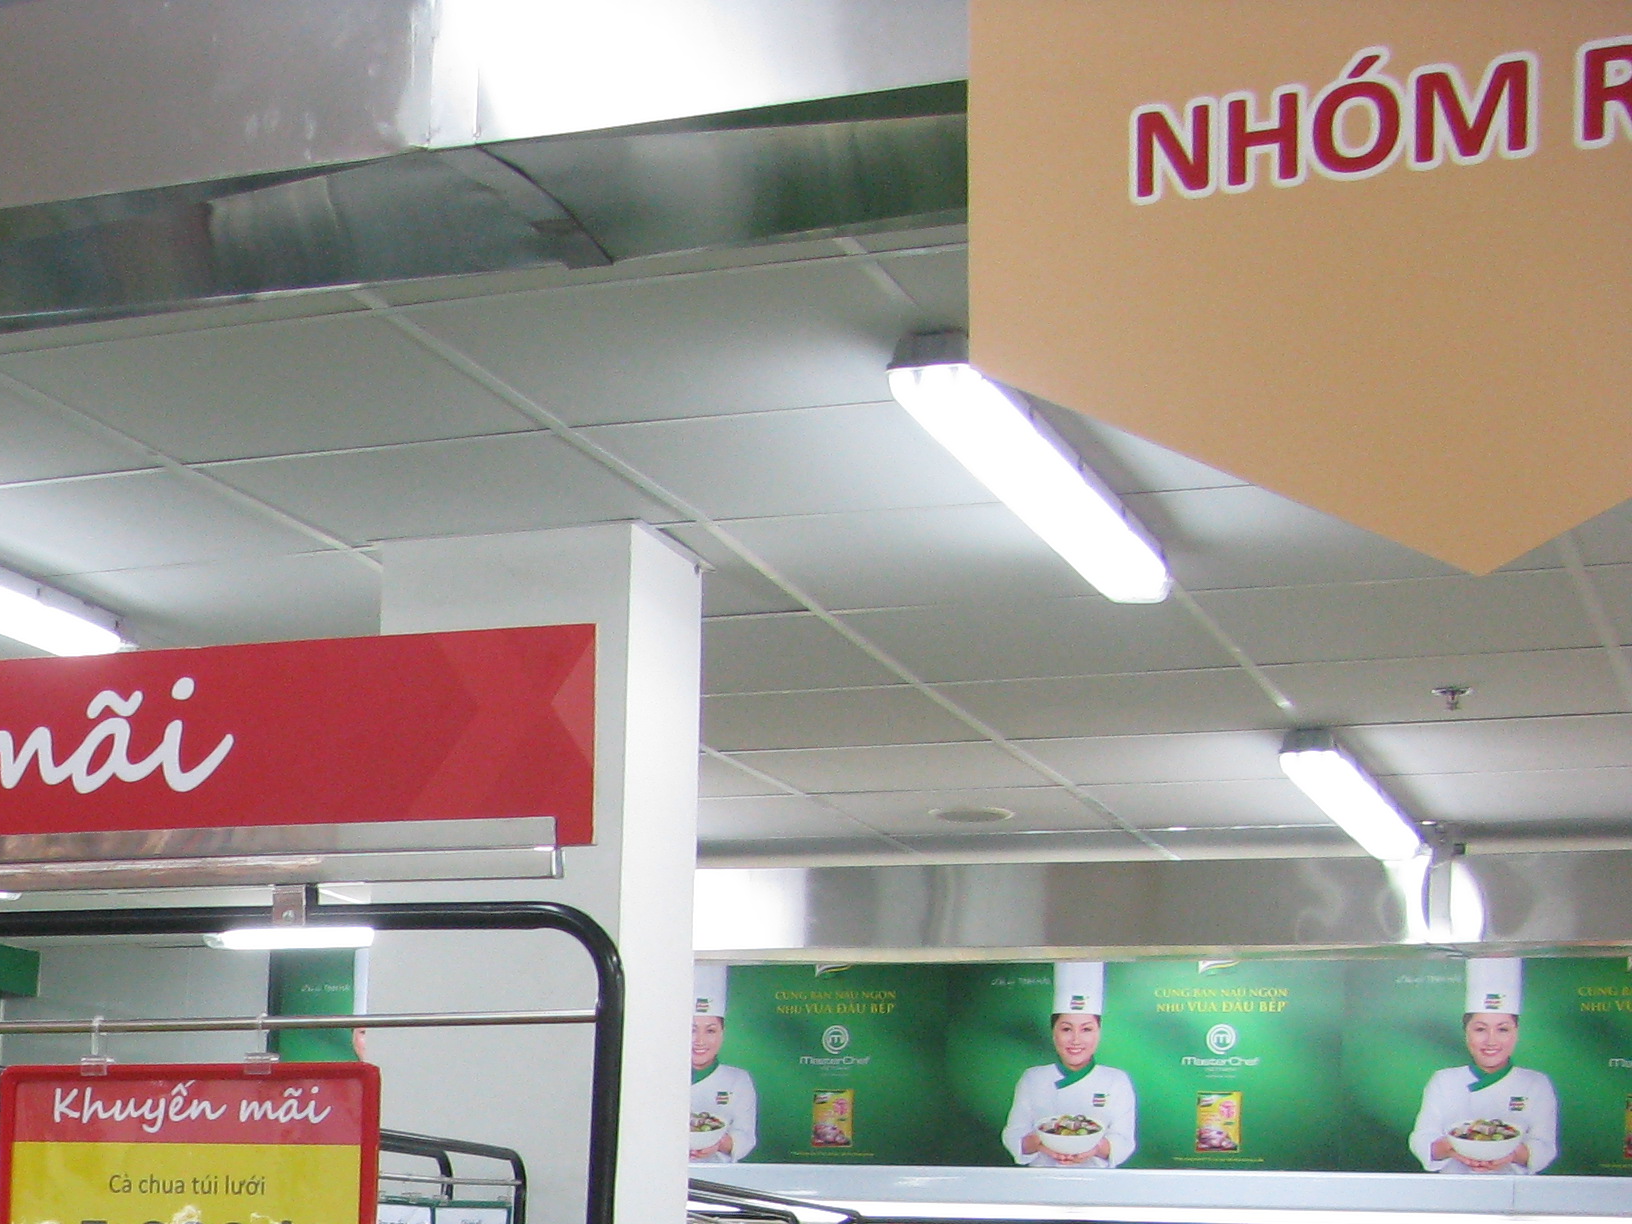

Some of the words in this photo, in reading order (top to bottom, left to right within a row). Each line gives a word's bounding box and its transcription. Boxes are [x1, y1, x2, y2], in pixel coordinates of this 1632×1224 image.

[1132, 48, 1538, 203] NHÓM
[53, 1080, 227, 1133] Khuyến
[239, 1086, 332, 1124] mãi
[109, 1172, 132, 1194] Cà
[139, 1174, 185, 1194] chua
[191, 1175, 219, 1195] túi
[225, 1174, 267, 1196] lưới
